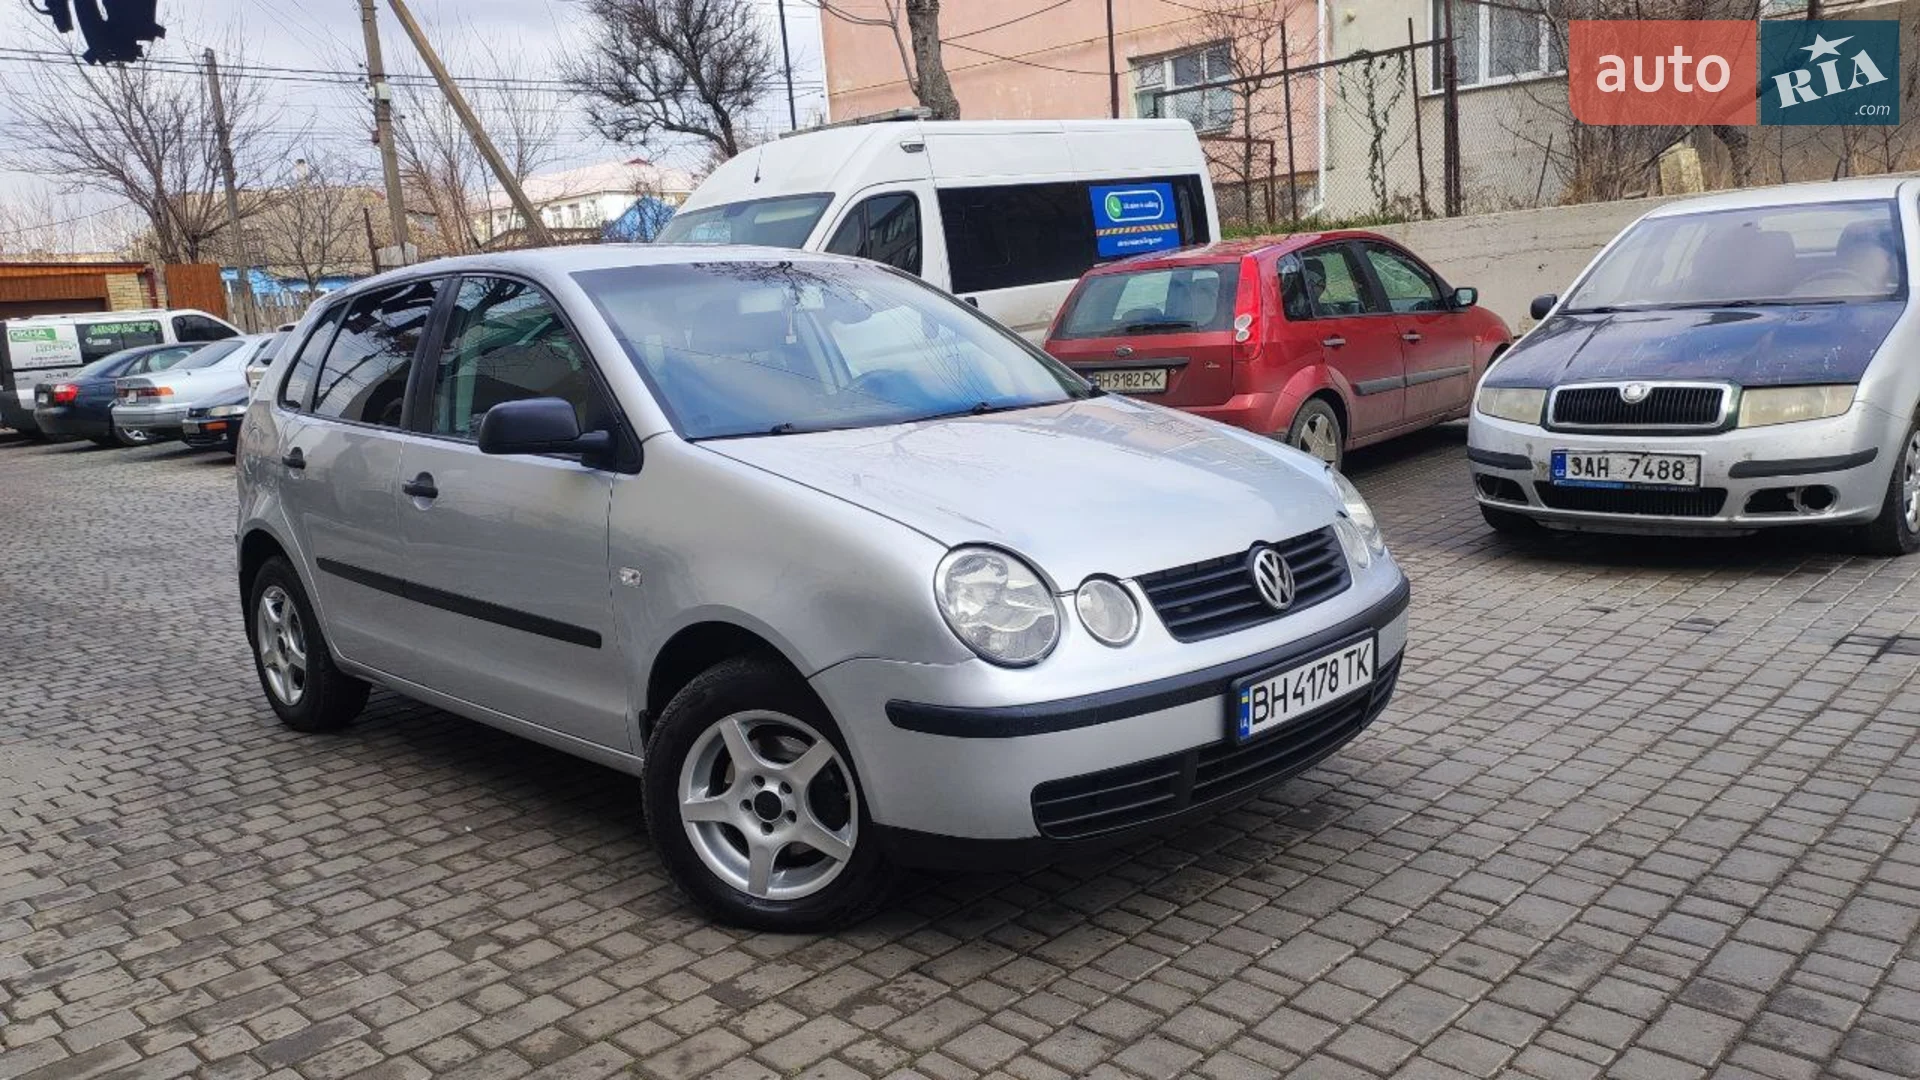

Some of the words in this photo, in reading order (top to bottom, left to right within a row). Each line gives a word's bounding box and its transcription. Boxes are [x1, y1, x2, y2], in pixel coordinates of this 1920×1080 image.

[1114, 371, 1141, 388] 9182
[1143, 371, 1163, 388] PK
[1570, 456, 1609, 478] 3AH
[1628, 458, 1686, 481] 7488
[1252, 677, 1288, 726] BH
[1292, 658, 1339, 707] 4178
[1344, 643, 1371, 685] TK
